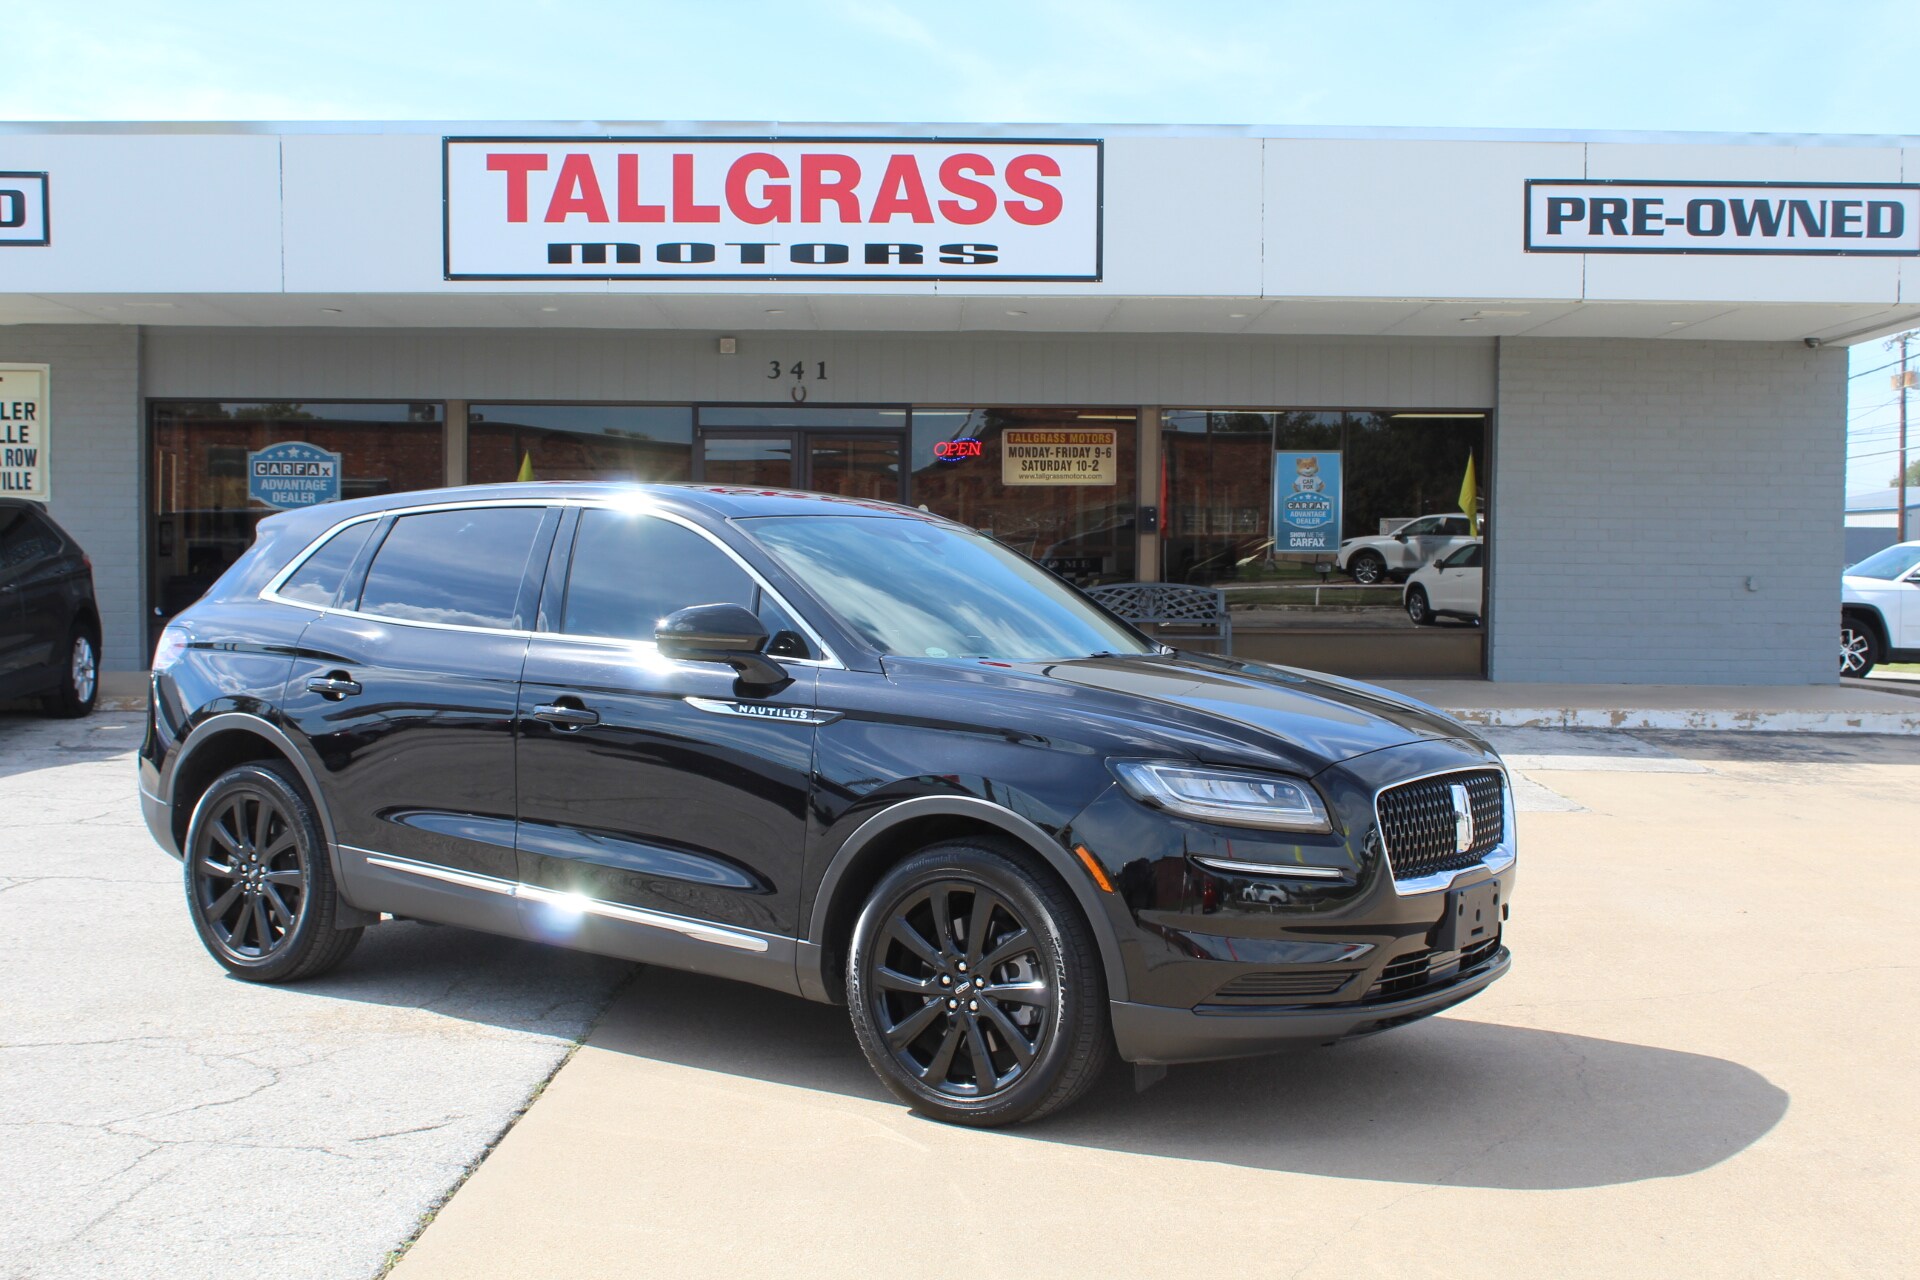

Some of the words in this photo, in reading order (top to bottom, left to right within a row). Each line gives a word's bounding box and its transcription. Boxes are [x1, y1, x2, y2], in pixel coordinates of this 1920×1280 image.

[486, 152, 1063, 225] TALLGRASS
[1546, 197, 1904, 239] PRE-OWNED
[767, 360, 828, 380] 341
[1009, 433, 1066, 443] TALLGRASS
[1070, 433, 1112, 444] MOTORS
[933, 441, 982, 456] OPEN
[1094, 446, 1112, 458] 9-6
[6, 448, 37, 467] ROW
[256, 462, 332, 477] CARFAX
[1021, 460, 1072, 471] SATURDAY
[1076, 460, 1099, 471] 10-2
[261, 479, 327, 491] ADVANTAGE
[272, 492, 316, 503] DEALER
[1287, 502, 1330, 510] CARFAX
[1289, 538, 1325, 547] CARFAX
[738, 704, 808, 719] NAUTILUS
